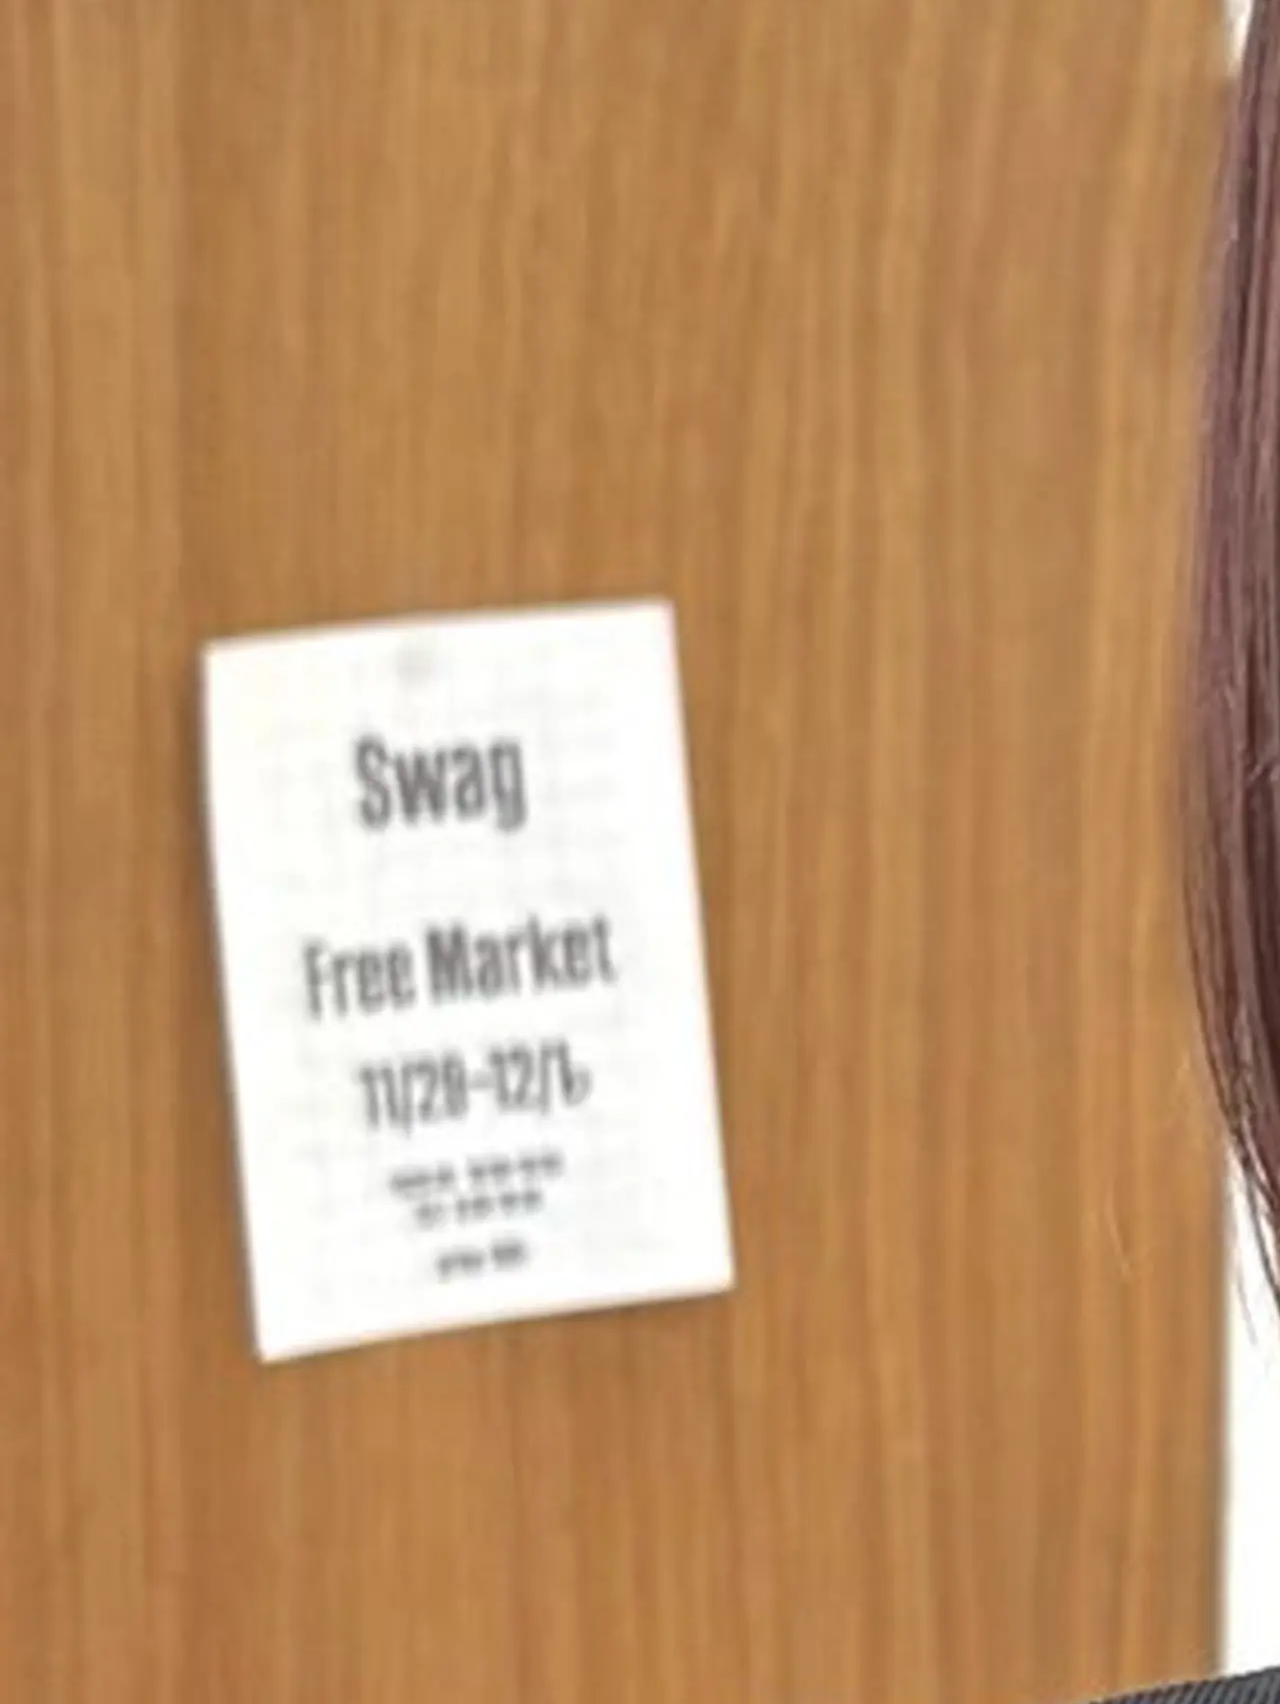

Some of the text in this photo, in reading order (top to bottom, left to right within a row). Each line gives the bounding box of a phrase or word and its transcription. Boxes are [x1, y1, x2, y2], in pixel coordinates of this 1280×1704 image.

[354, 735, 527, 833] Swag
[303, 916, 615, 1018] Free Market
